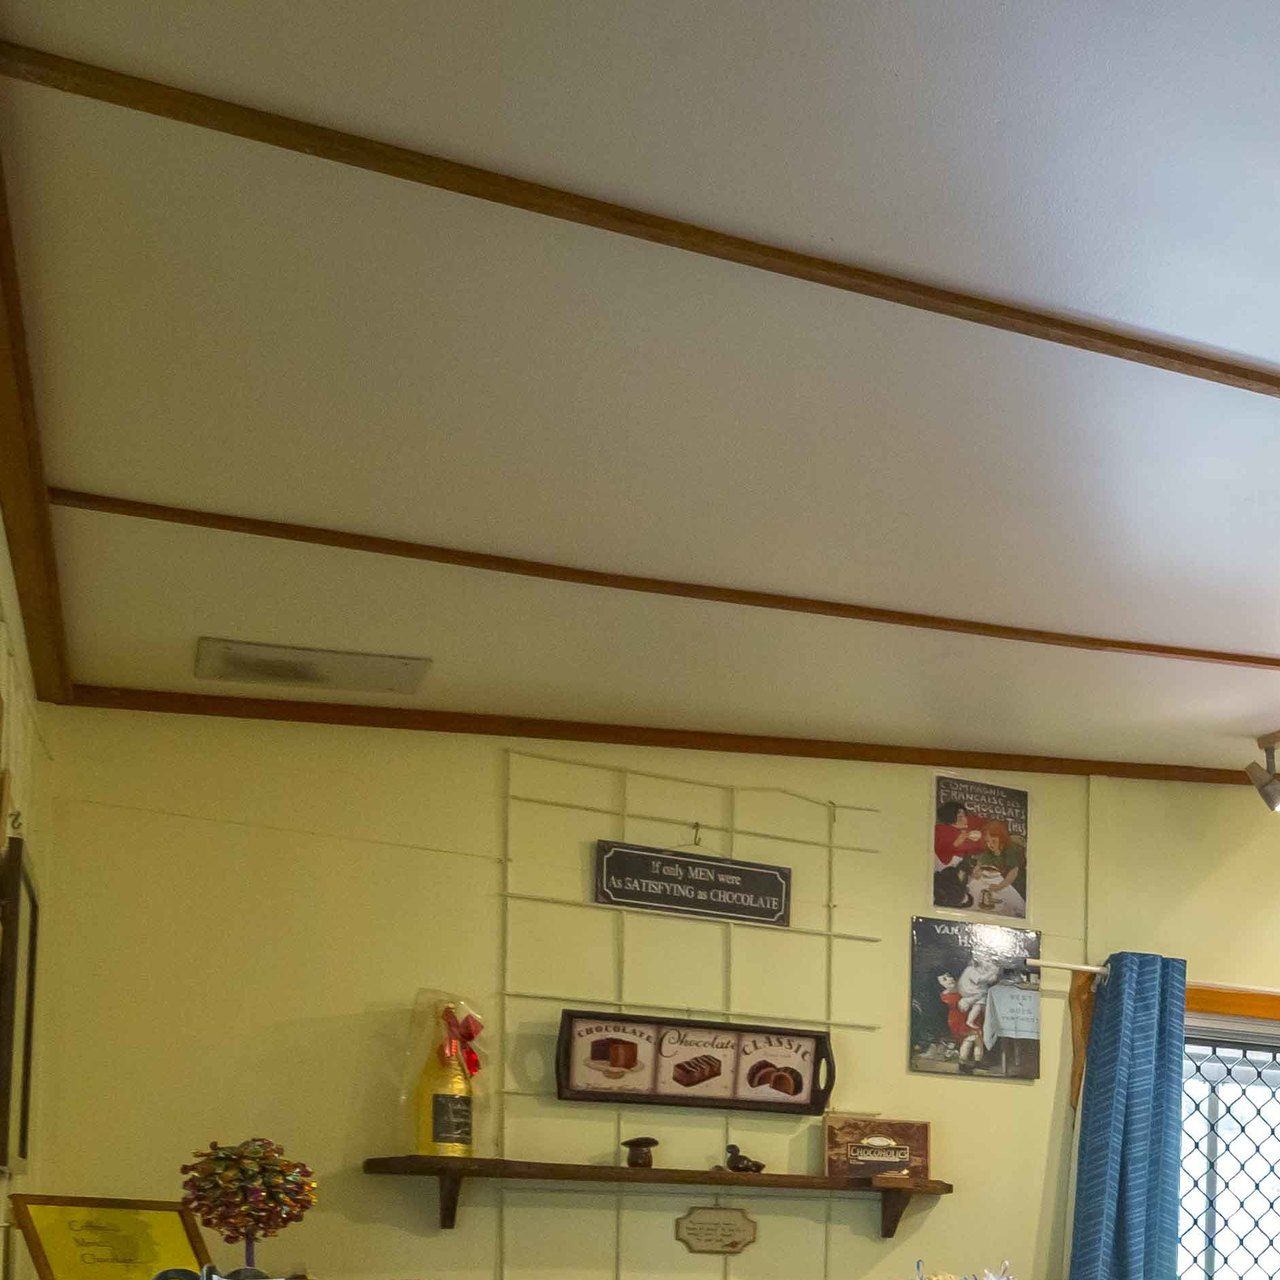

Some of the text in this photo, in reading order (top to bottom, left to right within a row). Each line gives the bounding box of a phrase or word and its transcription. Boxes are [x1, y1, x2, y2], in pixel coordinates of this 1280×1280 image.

[651, 861, 741, 885] If only MEN were
[609, 876, 778, 910] As SATISFYING as CHOCOLATE
[577, 1024, 656, 1045] CHOCOLATE
[742, 1036, 811, 1062] CLASSIC
